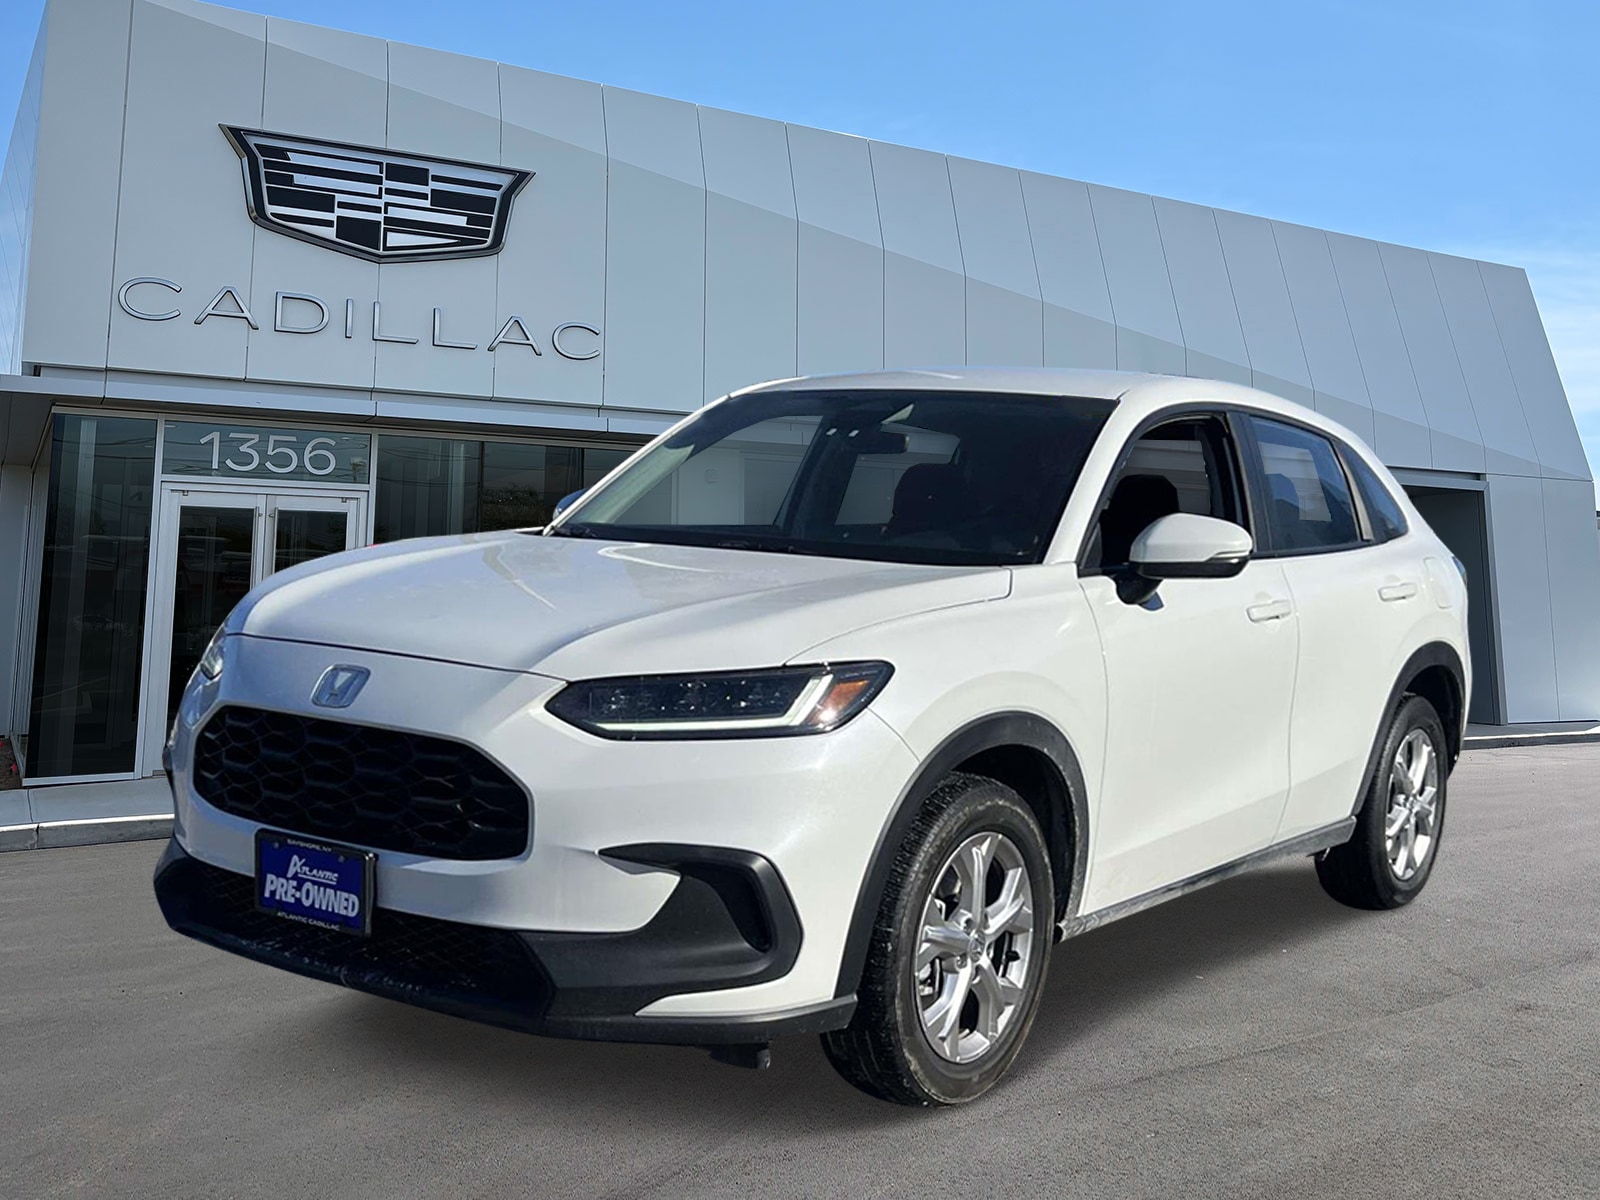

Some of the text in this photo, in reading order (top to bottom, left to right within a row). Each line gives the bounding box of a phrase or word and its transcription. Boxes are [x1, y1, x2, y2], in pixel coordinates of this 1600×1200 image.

[118, 276, 601, 361] CADILLAC
[198, 431, 337, 476] 1356
[286, 854, 339, 881] ATLANTIC
[264, 873, 360, 917] PRE-OWNED
